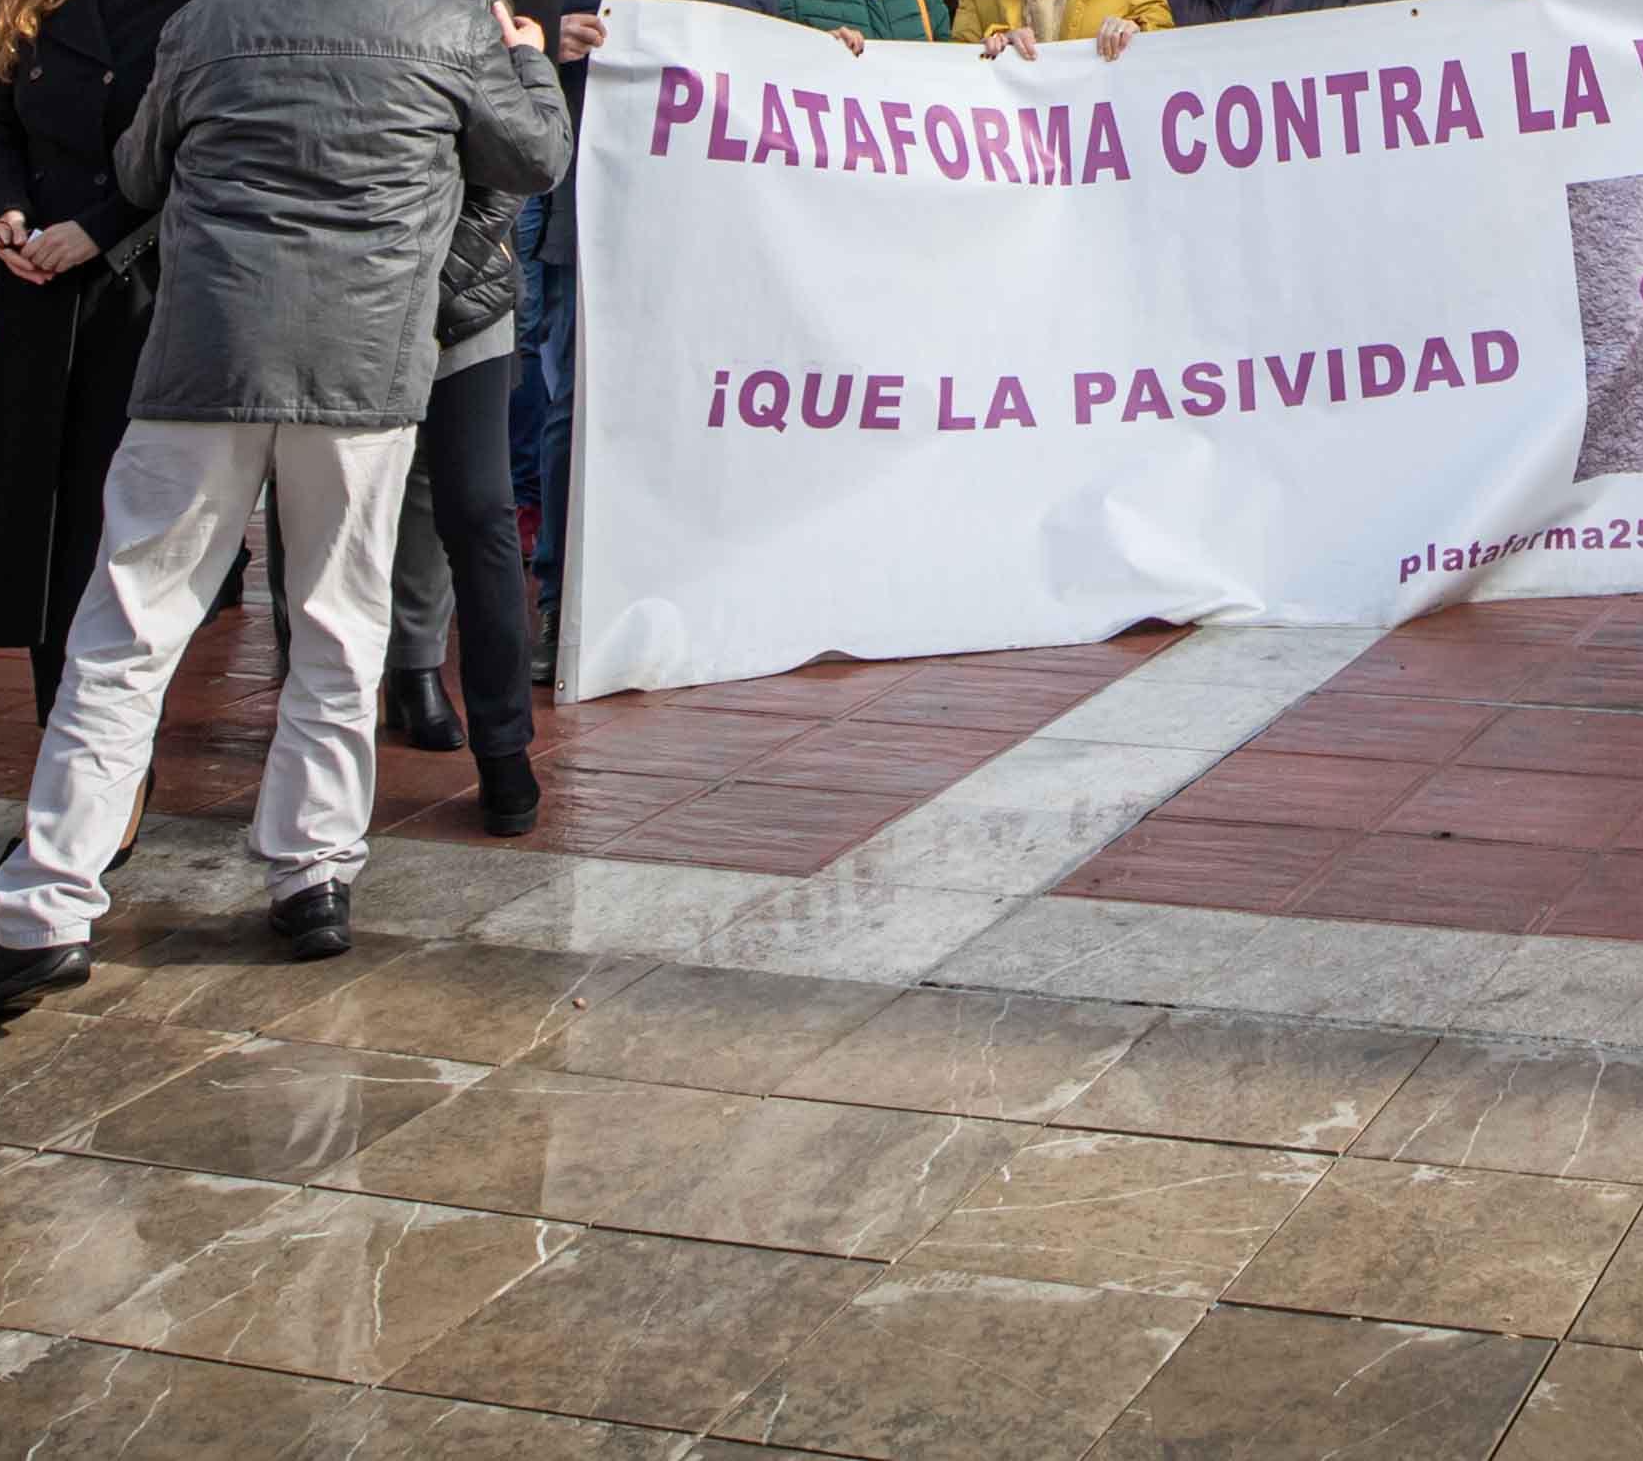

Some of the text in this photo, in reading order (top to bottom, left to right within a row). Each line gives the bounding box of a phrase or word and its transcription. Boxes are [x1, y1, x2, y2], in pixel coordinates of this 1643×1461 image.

[650, 64, 1133, 187] PLATAFORMA
[1160, 58, 1485, 174] CONTRA
[1510, 43, 1611, 135] LA
[706, 328, 1521, 433] ¡QUE LA PASIVIDAD
